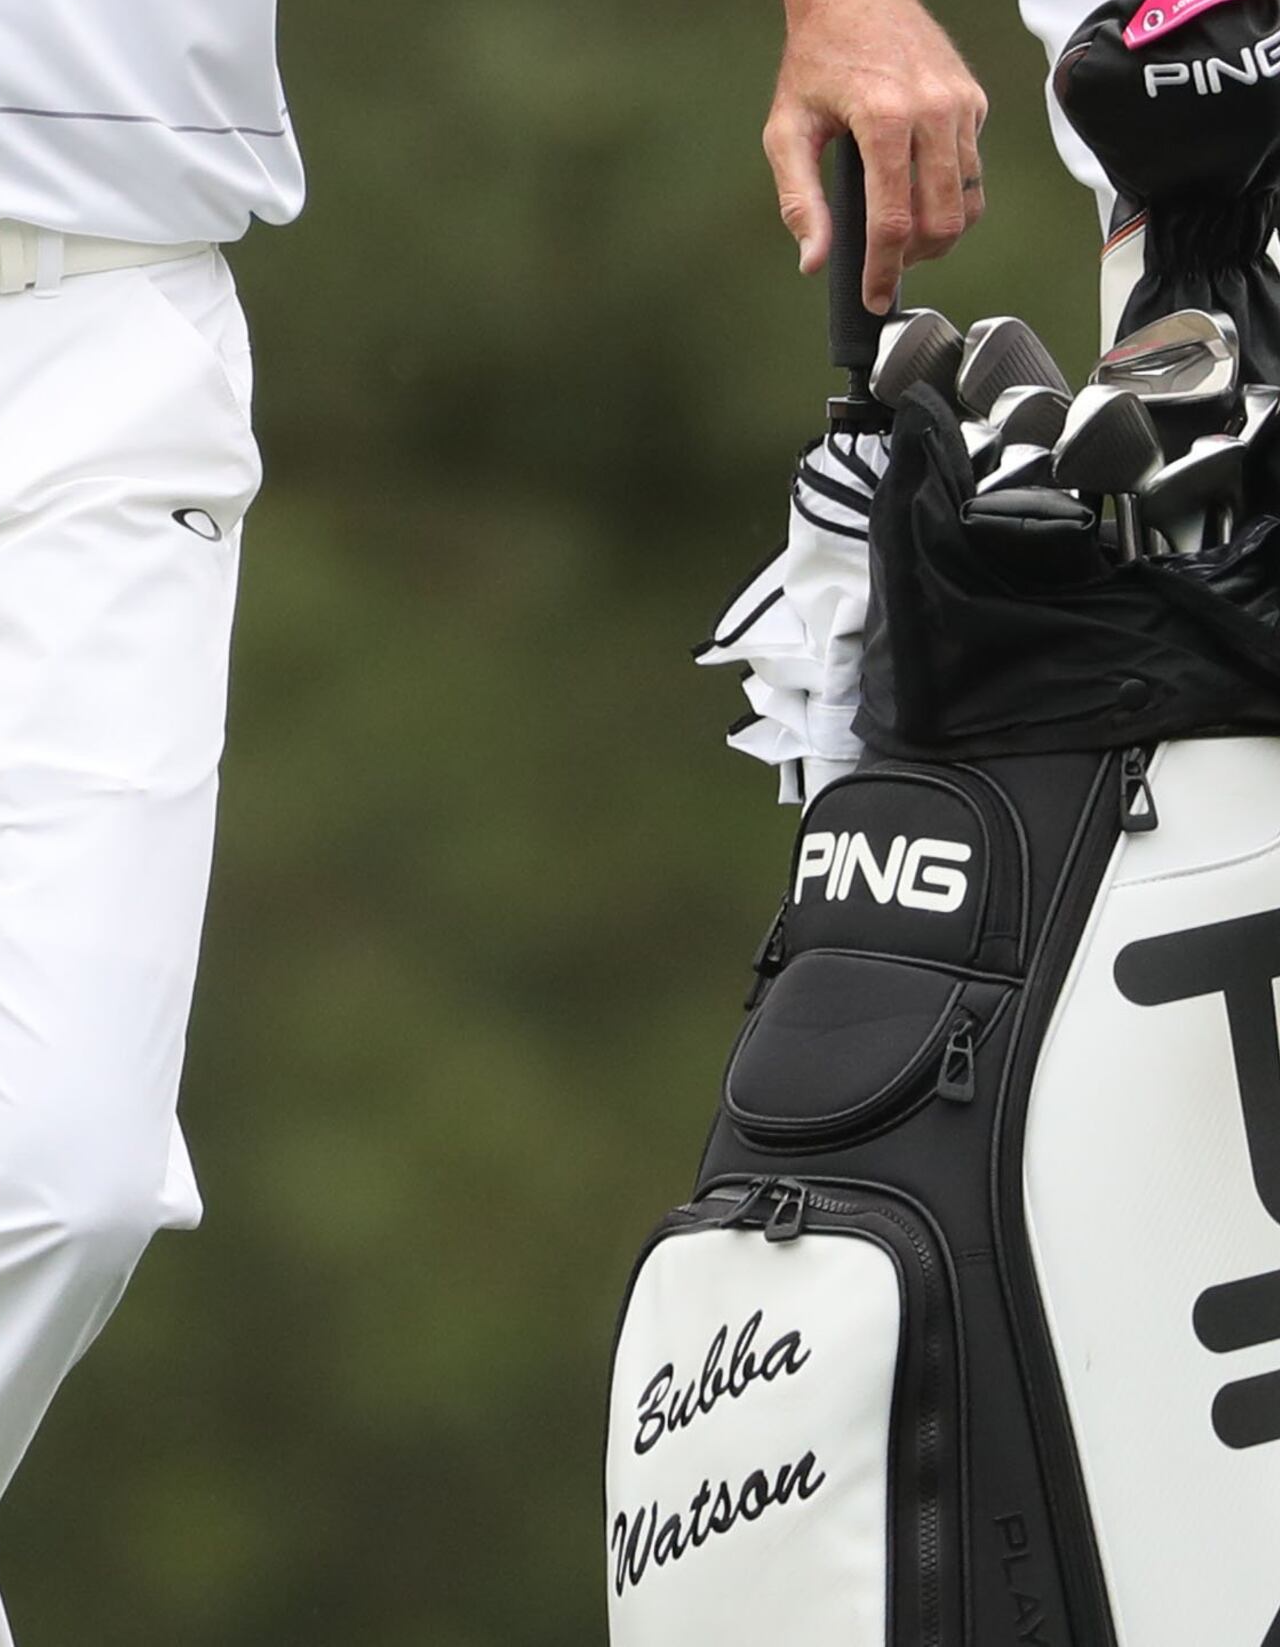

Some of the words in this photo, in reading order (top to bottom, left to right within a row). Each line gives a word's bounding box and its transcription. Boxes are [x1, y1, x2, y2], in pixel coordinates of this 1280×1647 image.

[793, 830, 973, 914] PING
[634, 1309, 812, 1456] Bubba
[611, 1450, 826, 1597] Watson
